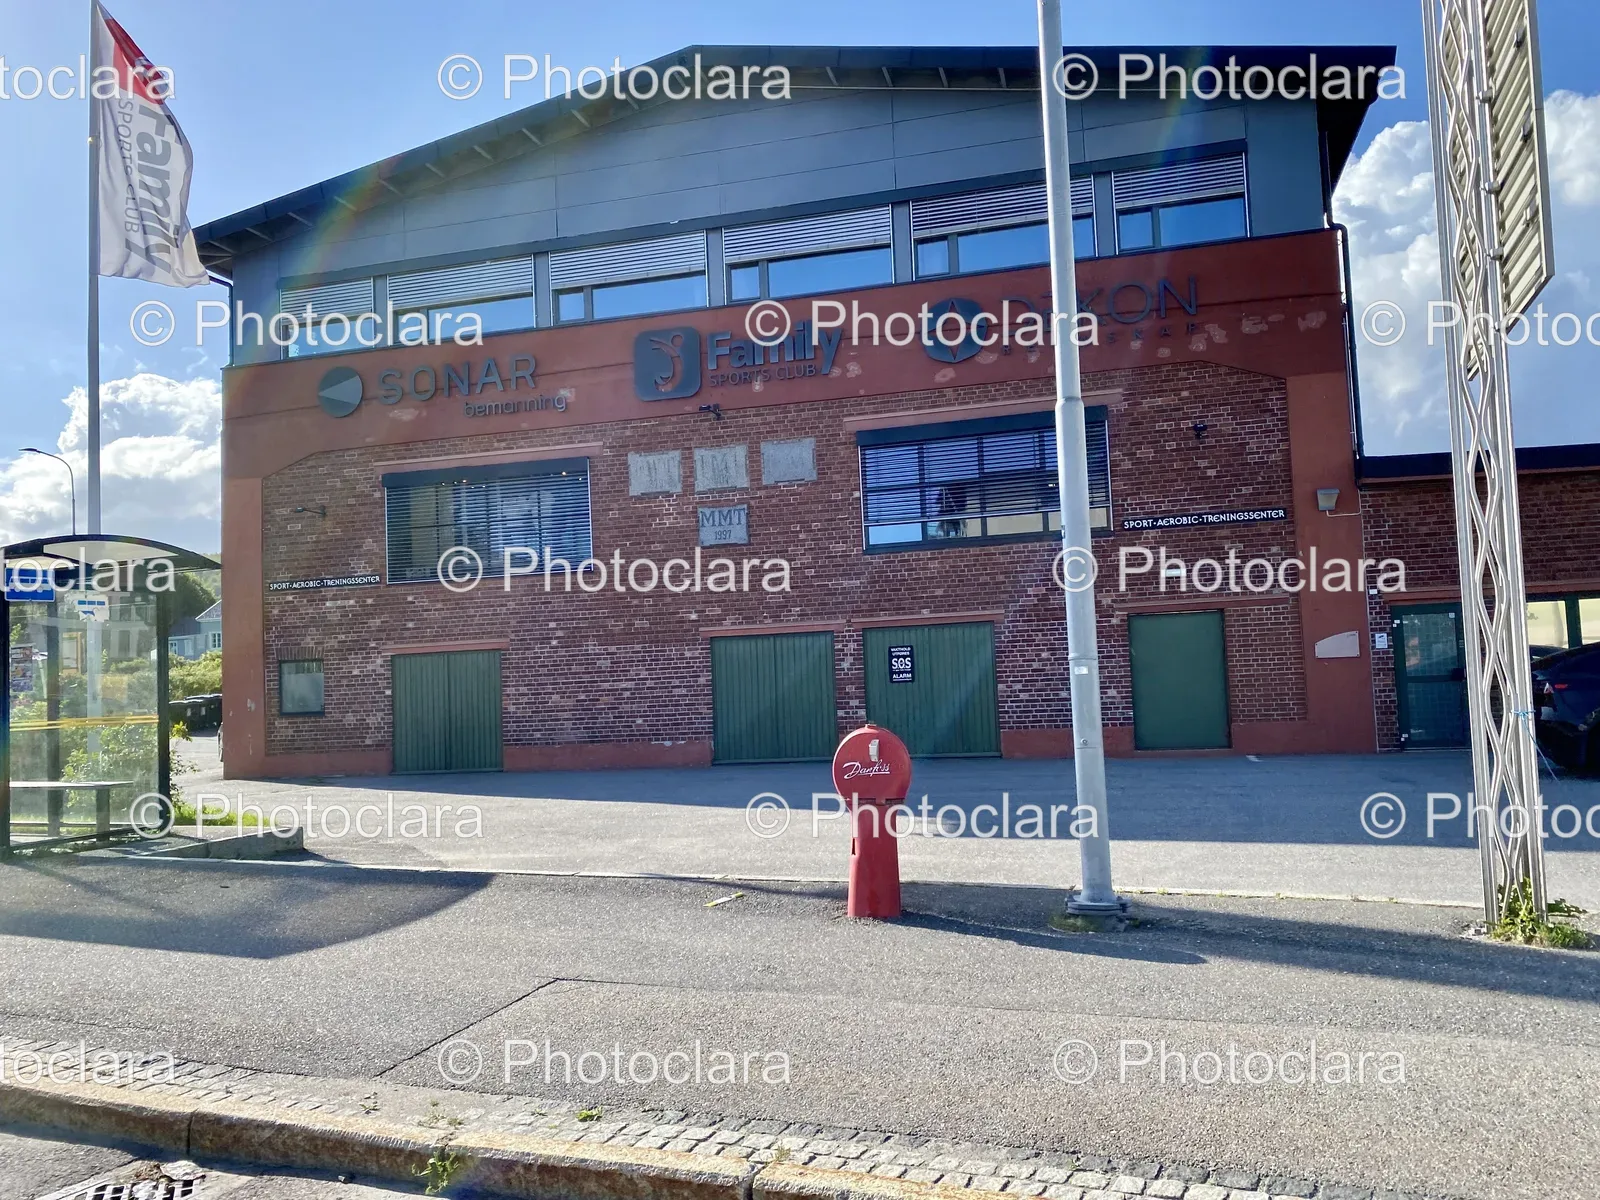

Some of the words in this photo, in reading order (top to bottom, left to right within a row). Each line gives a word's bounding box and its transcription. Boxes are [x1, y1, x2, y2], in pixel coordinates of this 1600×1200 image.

[125, 104, 182, 274] Family
[124, 183, 139, 234] CLUB
[707, 319, 843, 375] Family
[378, 353, 537, 406] SONAR
[709, 368, 770, 387] SPORTS
[775, 364, 816, 380] CLUB
[464, 393, 568, 417] bemanning
[700, 508, 746, 528] MMT
[714, 530, 732, 540] 1997
